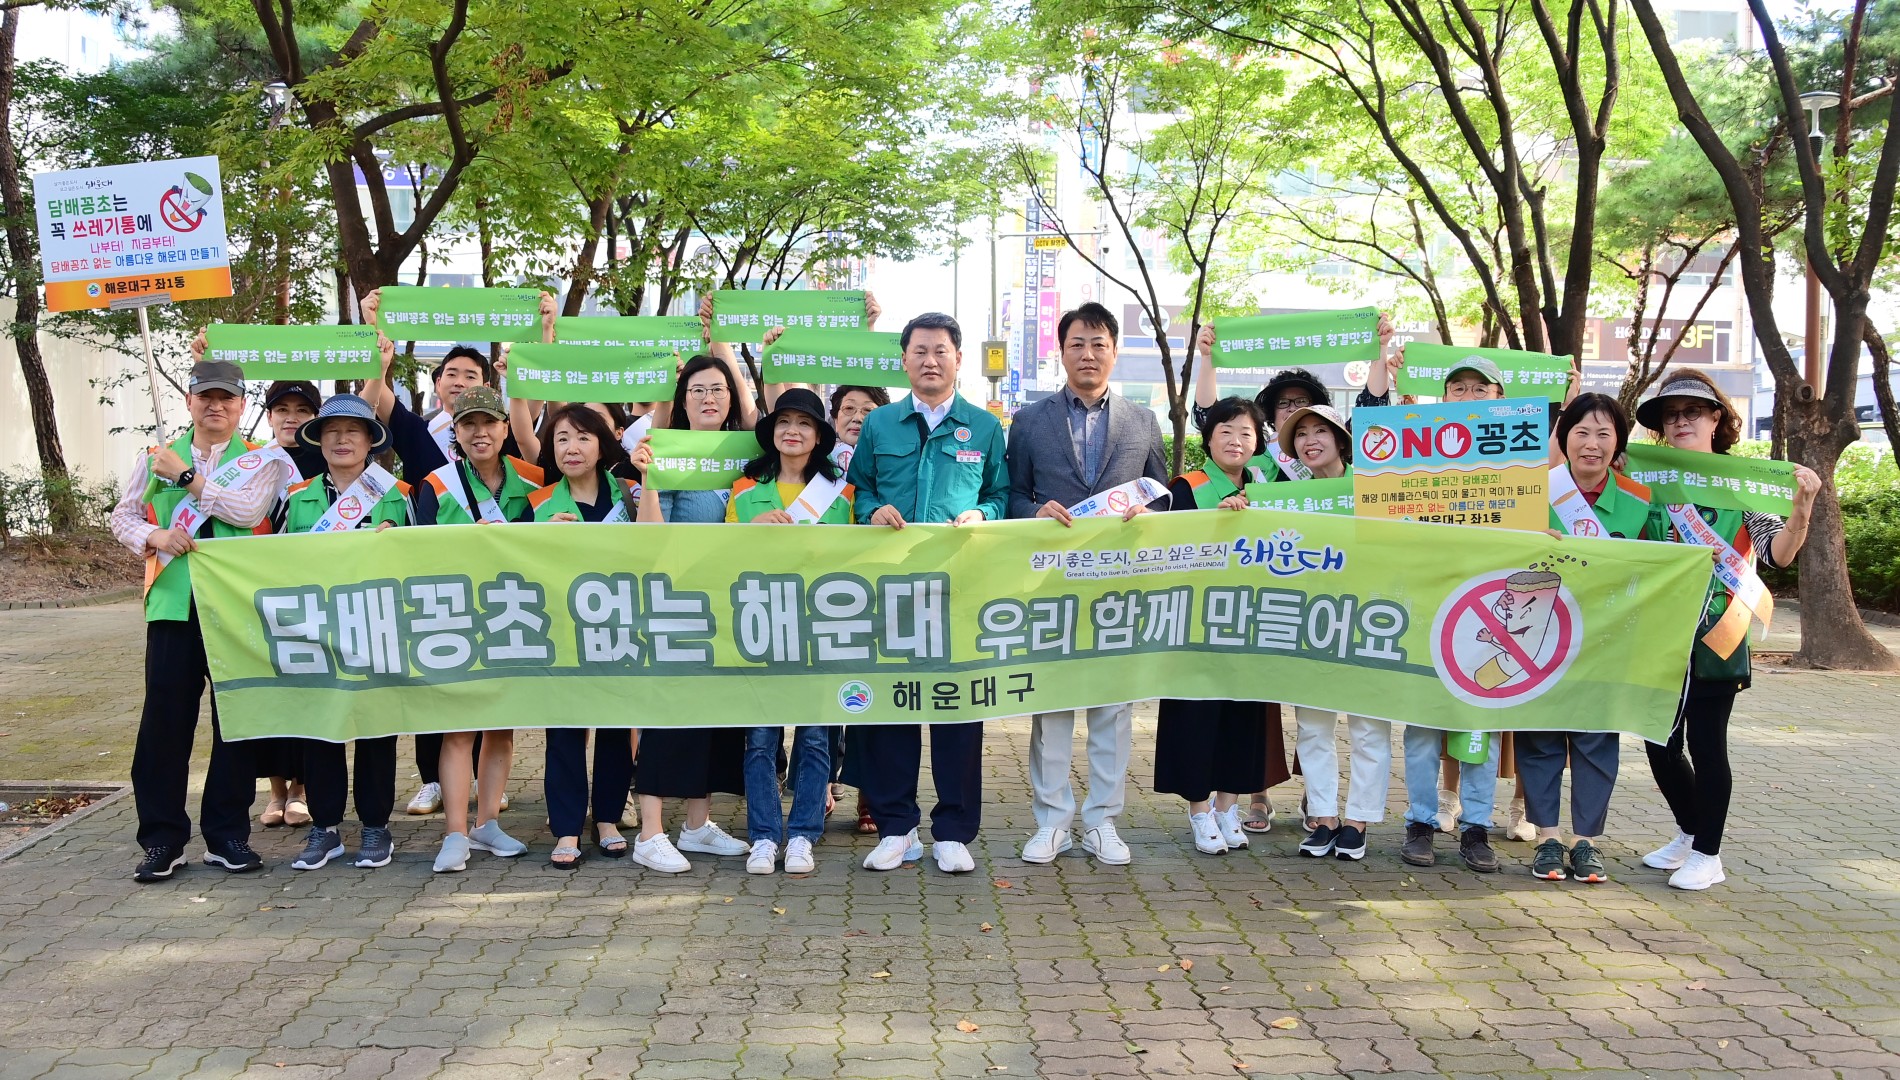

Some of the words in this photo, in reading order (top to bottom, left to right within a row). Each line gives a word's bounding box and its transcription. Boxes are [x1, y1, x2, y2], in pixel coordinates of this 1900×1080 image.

[48, 194, 128, 218] 담배꽁초는
[51, 222, 66, 241] 꼭
[72, 214, 153, 239] 쓰레기통에
[90, 240, 124, 254] 나부터!
[132, 235, 176, 250] 지금부터!
[51, 258, 89, 273] 담배꽁초
[93, 257, 112, 270] 없는
[115, 252, 154, 268] 아름다운
[157, 249, 187, 264] 해운대
[190, 246, 220, 261] 만들기
[104, 279, 151, 295] 해운대구
[155, 276, 186, 290] 좌1동
[384, 311, 429, 325] 담배꽁초
[432, 312, 455, 326] 없는
[458, 313, 486, 327] 좌1동
[489, 313, 534, 327] 청결맛집
[716, 314, 759, 327] 담배꽁초
[762, 314, 784, 327] 없는
[787, 315, 813, 328] 좌1동
[817, 315, 860, 328] 청결맛집
[1219, 338, 1265, 353] 담배꽁초
[1268, 337, 1291, 350] 없는
[1294, 335, 1322, 348] 좌1동
[1326, 331, 1373, 347] 청결맛집
[1679, 324, 1714, 349] 3F
[211, 350, 260, 363] 담배꽁초
[264, 351, 287, 363] 없는
[291, 350, 320, 363] 좌1동
[325, 350, 372, 363] 청결맛집
[771, 353, 817, 367] 담배꽁초
[820, 356, 842, 368] 없는
[846, 357, 874, 370] 좌1동
[516, 367, 562, 383] 담배꽁초
[565, 371, 588, 385] 없는
[592, 371, 620, 385] 좌1동
[624, 370, 668, 385] 청결맛집
[1518, 370, 1567, 384] 청결맛집
[1475, 421, 1541, 455] 꽁초
[654, 457, 697, 472] 담배꽁초
[700, 458, 720, 472] 없는
[1401, 477, 1428, 488] 바다로
[1432, 475, 1459, 487] 흘러간
[1462, 473, 1502, 486] 담배꽁초!
[1630, 470, 1679, 485] 담배꽁초
[1683, 471, 1708, 488] 없는
[1711, 475, 1741, 491] 좌1동
[1744, 479, 1794, 500] 청결맛집
[1361, 492, 1378, 504] 해양
[1381, 489, 1439, 502] 미세플라스틱이
[1441, 488, 1458, 500] 되어
[1461, 487, 1486, 499] 물고기
[1489, 486, 1514, 498] 먹이가
[1517, 484, 1542, 496] 됩니다
[1388, 503, 1424, 515] 담배꽁초
[1428, 502, 1446, 513] 없는
[1448, 500, 1485, 512] 아름다운
[1488, 498, 1516, 510] 해운대
[1470, 511, 1502, 524] 좌1동
[1032, 553, 1061, 569] 살기
[1066, 552, 1094, 568] 좋은
[1098, 550, 1131, 567] 도시,
[1135, 548, 1164, 563] 오고
[1168, 545, 1195, 561] 싶은
[1199, 543, 1228, 557] 도시
[1232, 539, 1344, 576] 해운대
[261, 579, 548, 675] 담배꽁초
[574, 579, 709, 663] 없는
[738, 578, 943, 662] 해운대
[980, 599, 1074, 661] 우리
[1095, 590, 1189, 651] 함께
[1205, 589, 1406, 661] 만들어요
